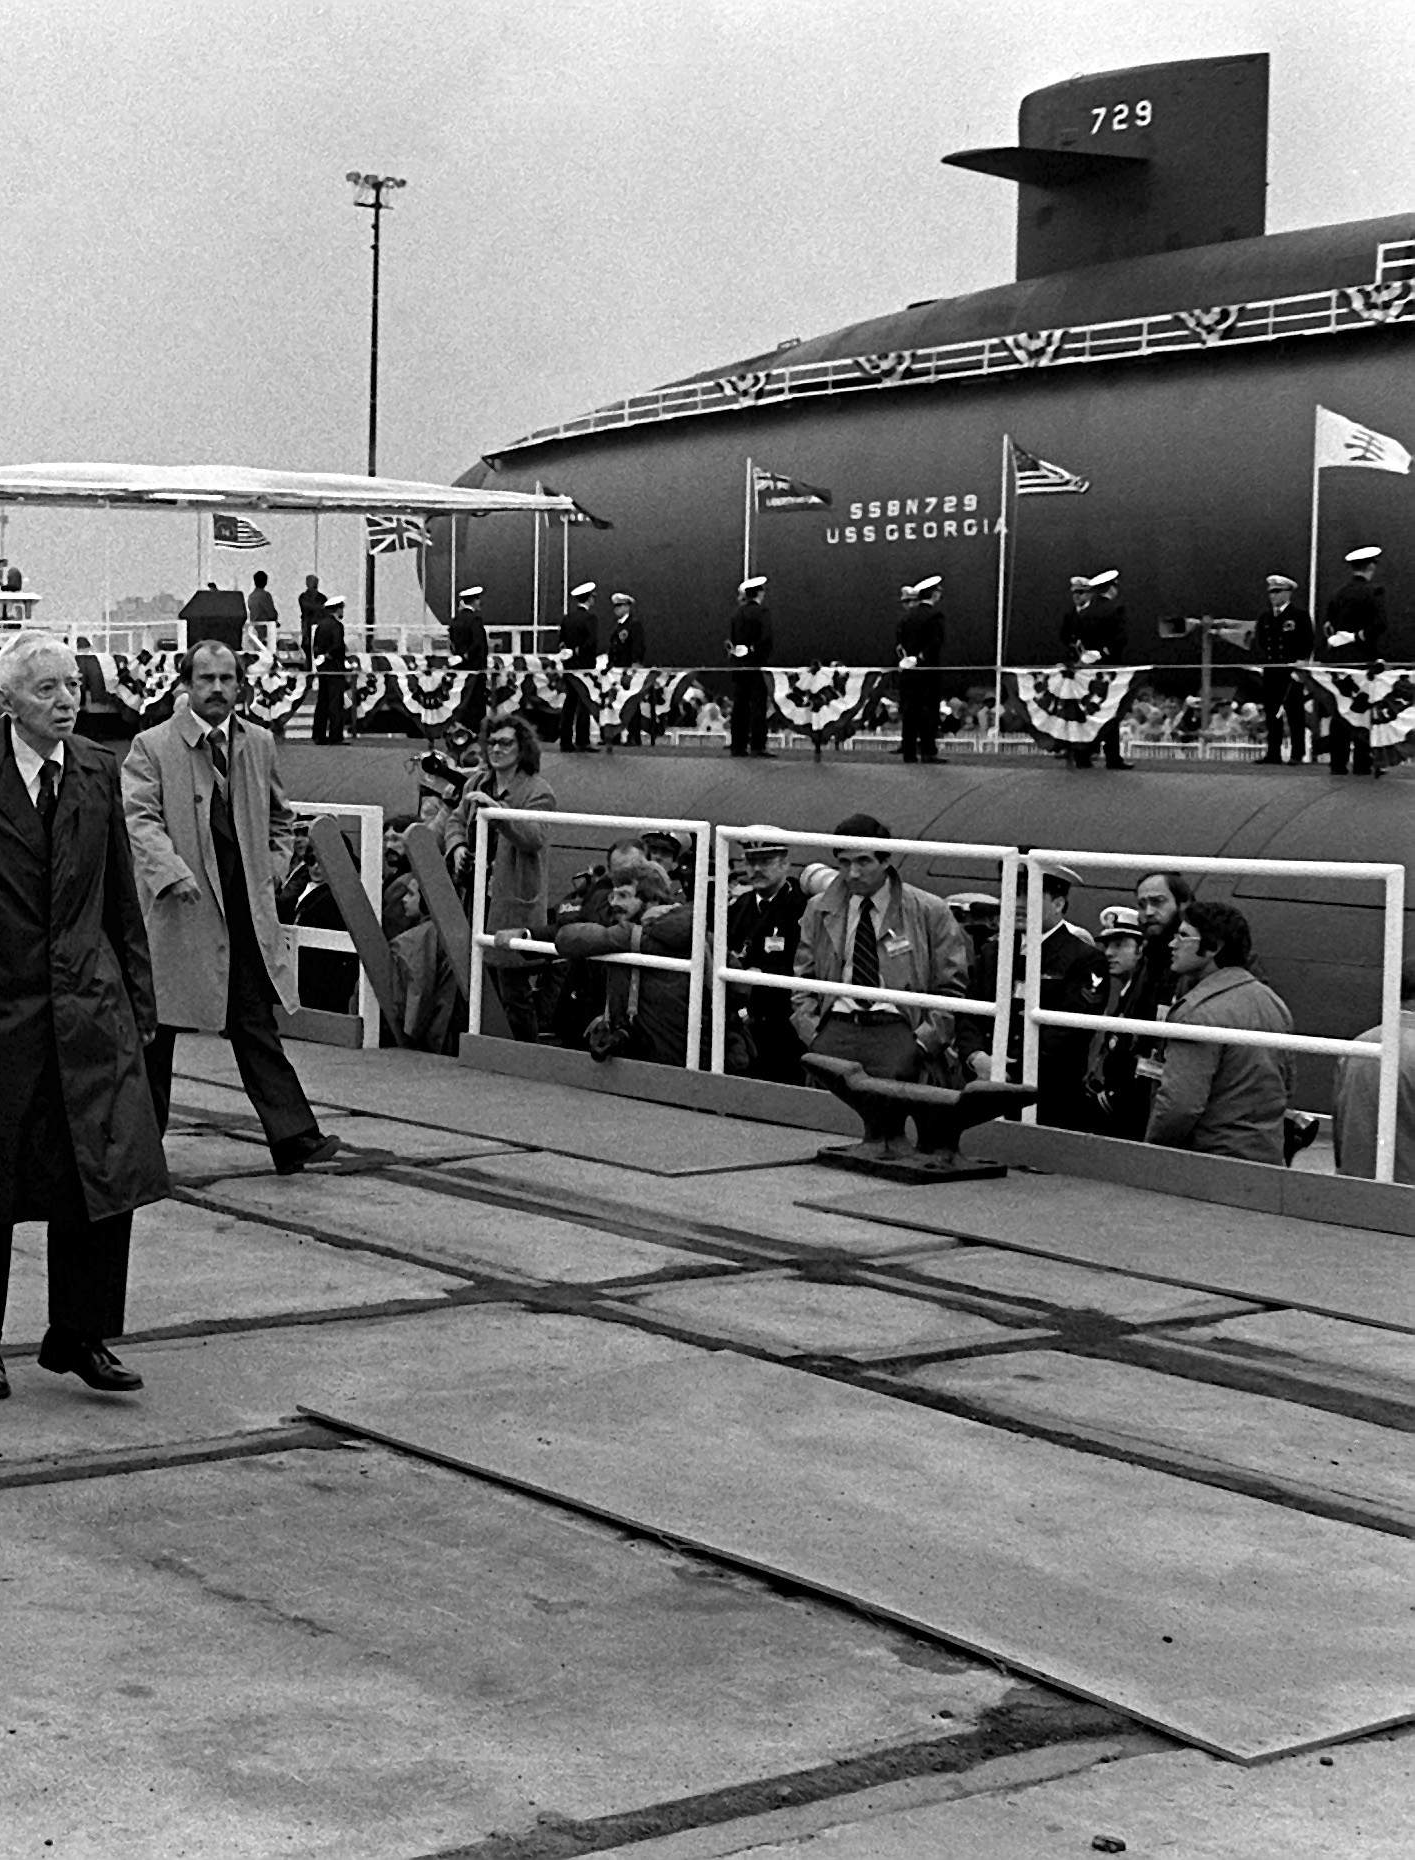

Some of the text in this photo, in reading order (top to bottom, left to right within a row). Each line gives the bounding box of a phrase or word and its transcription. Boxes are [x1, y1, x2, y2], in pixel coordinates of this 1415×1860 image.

[1090, 100, 1152, 135] 729
[826, 518, 1008, 544] USS GEORGIA
